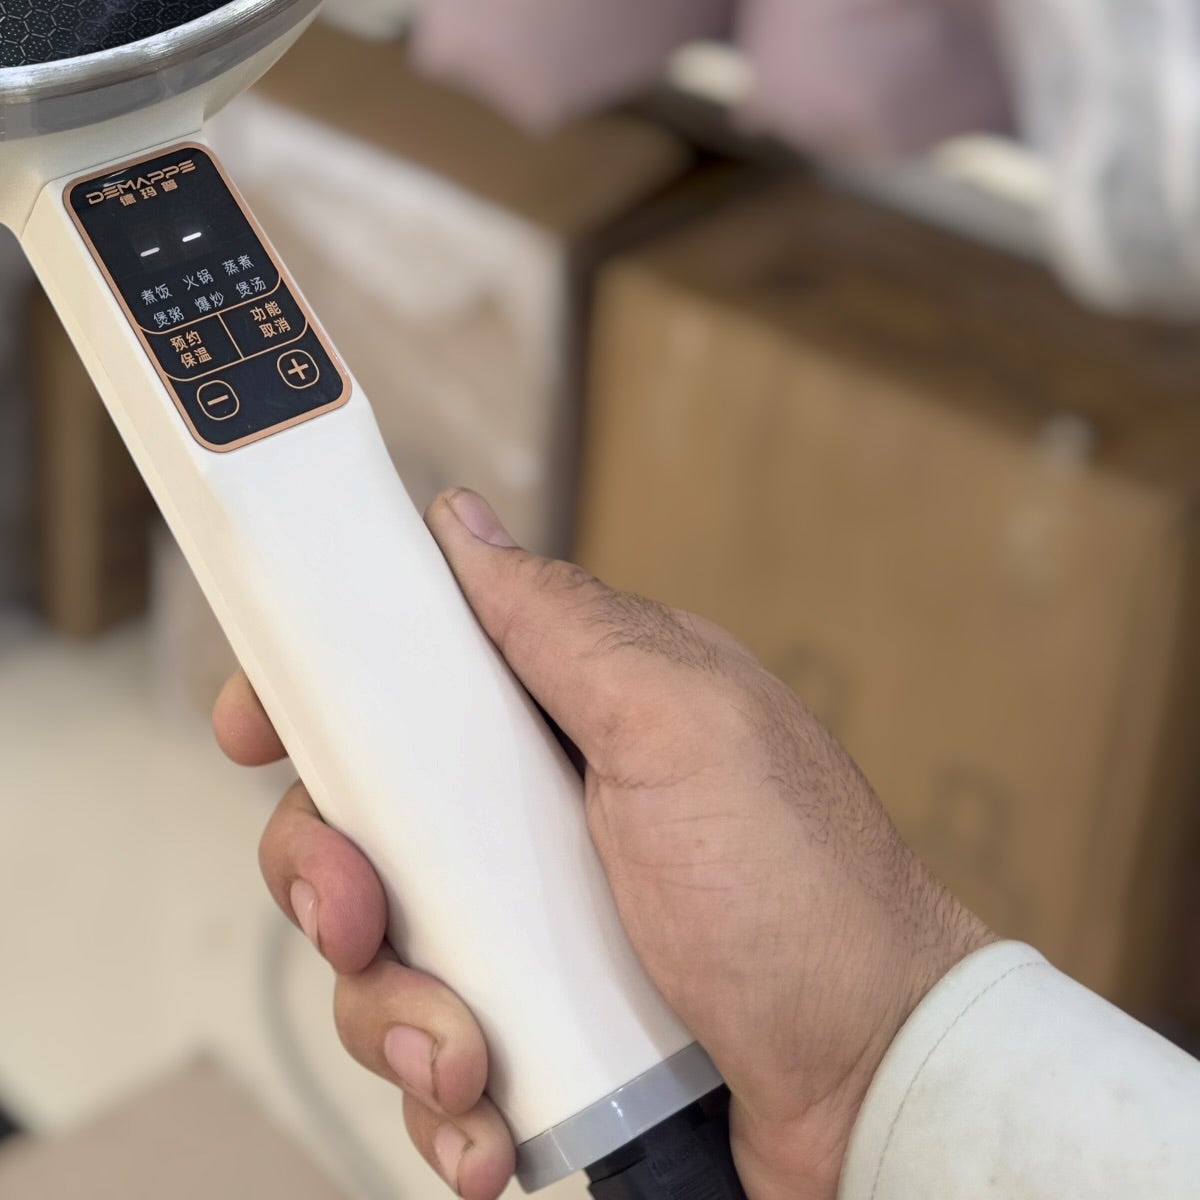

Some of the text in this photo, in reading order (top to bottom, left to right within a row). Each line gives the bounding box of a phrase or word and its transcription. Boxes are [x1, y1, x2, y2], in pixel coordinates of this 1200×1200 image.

[86, 160, 196, 205] DEMAPPE
[141, 254, 255, 305] 煮饭 火锅 蒸煮
[153, 276, 267, 329] 煲粥 爆炒 煲汤
[250, 300, 282, 321] 功能
[258, 317, 291, 338] 取消
[169, 330, 202, 352] 预约
[180, 346, 212, 369] 保温
